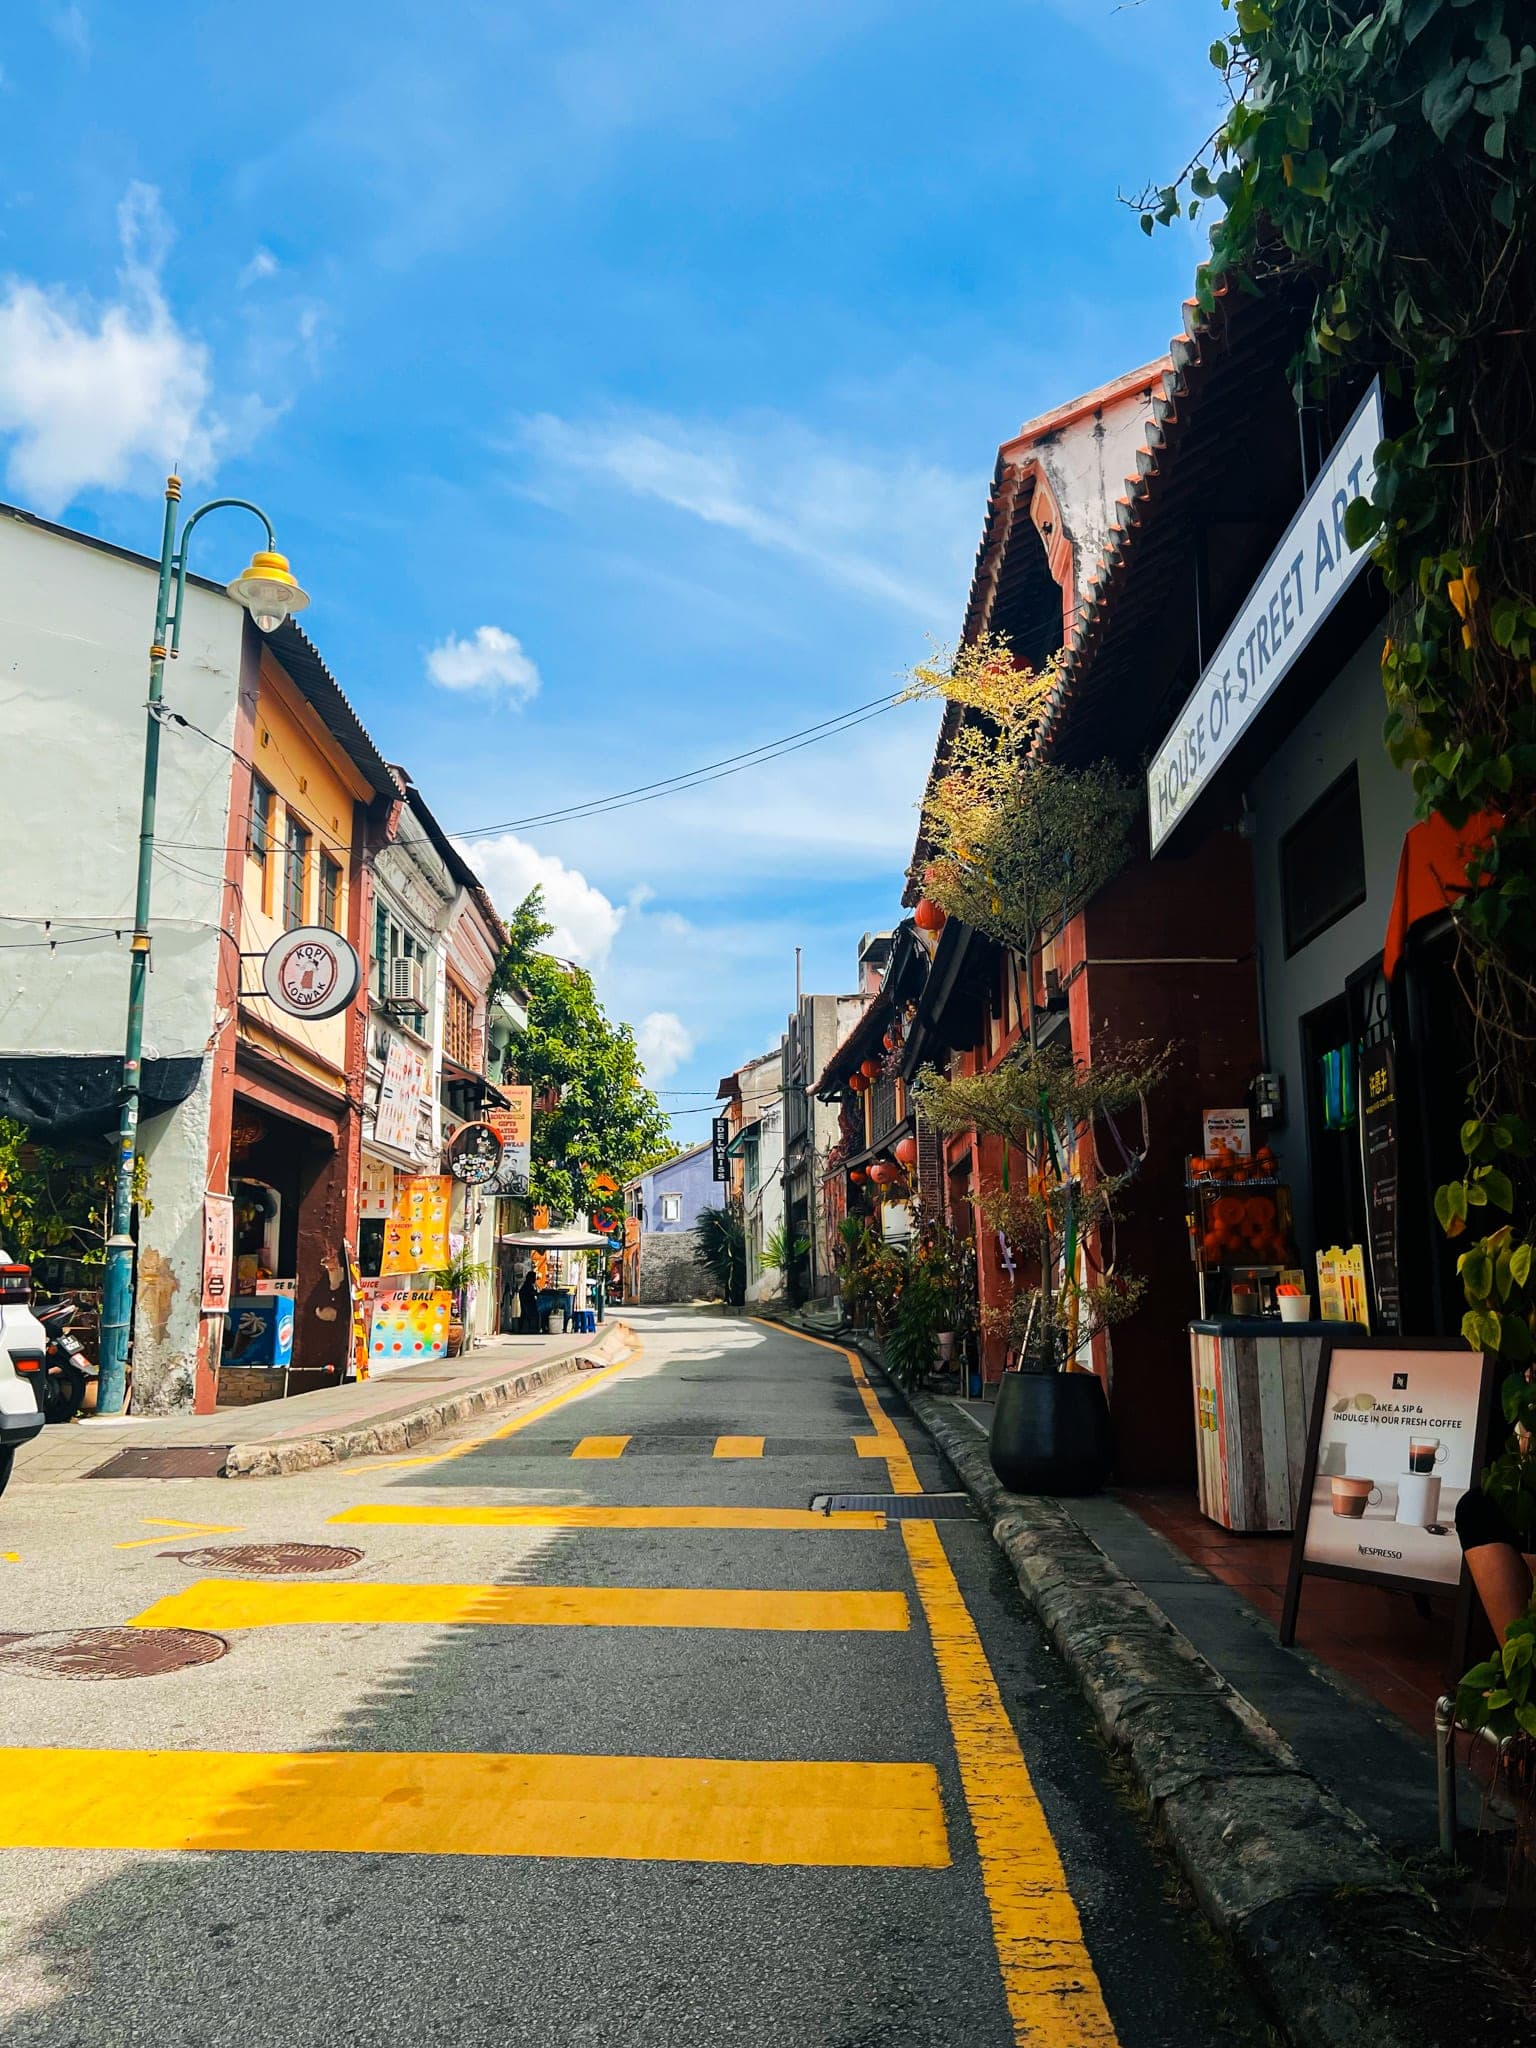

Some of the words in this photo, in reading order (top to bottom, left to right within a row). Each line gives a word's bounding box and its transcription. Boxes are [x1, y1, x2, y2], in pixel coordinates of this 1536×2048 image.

[1158, 713, 1206, 822] HOUSE
[1210, 668, 1232, 742] OF
[1237, 549, 1304, 704] STREET
[287, 981, 326, 1002] LOEWAK
[716, 1119, 726, 1180] EDELWEISS
[393, 1292, 410, 1300] ICE
[411, 1292, 434, 1300] BALL
[1372, 1403, 1392, 1412] TAKE
[1402, 1405, 1414, 1413] SIP
[1416, 1406, 1423, 1414] &
[1333, 1413, 1369, 1423] INDULGE
[1370, 1415, 1380, 1423] IN
[1381, 1416, 1400, 1425] OUR
[1401, 1417, 1427, 1427] FRESH
[1429, 1419, 1463, 1429] COFFEE
[1358, 1544, 1402, 1559] NESPRESSO
